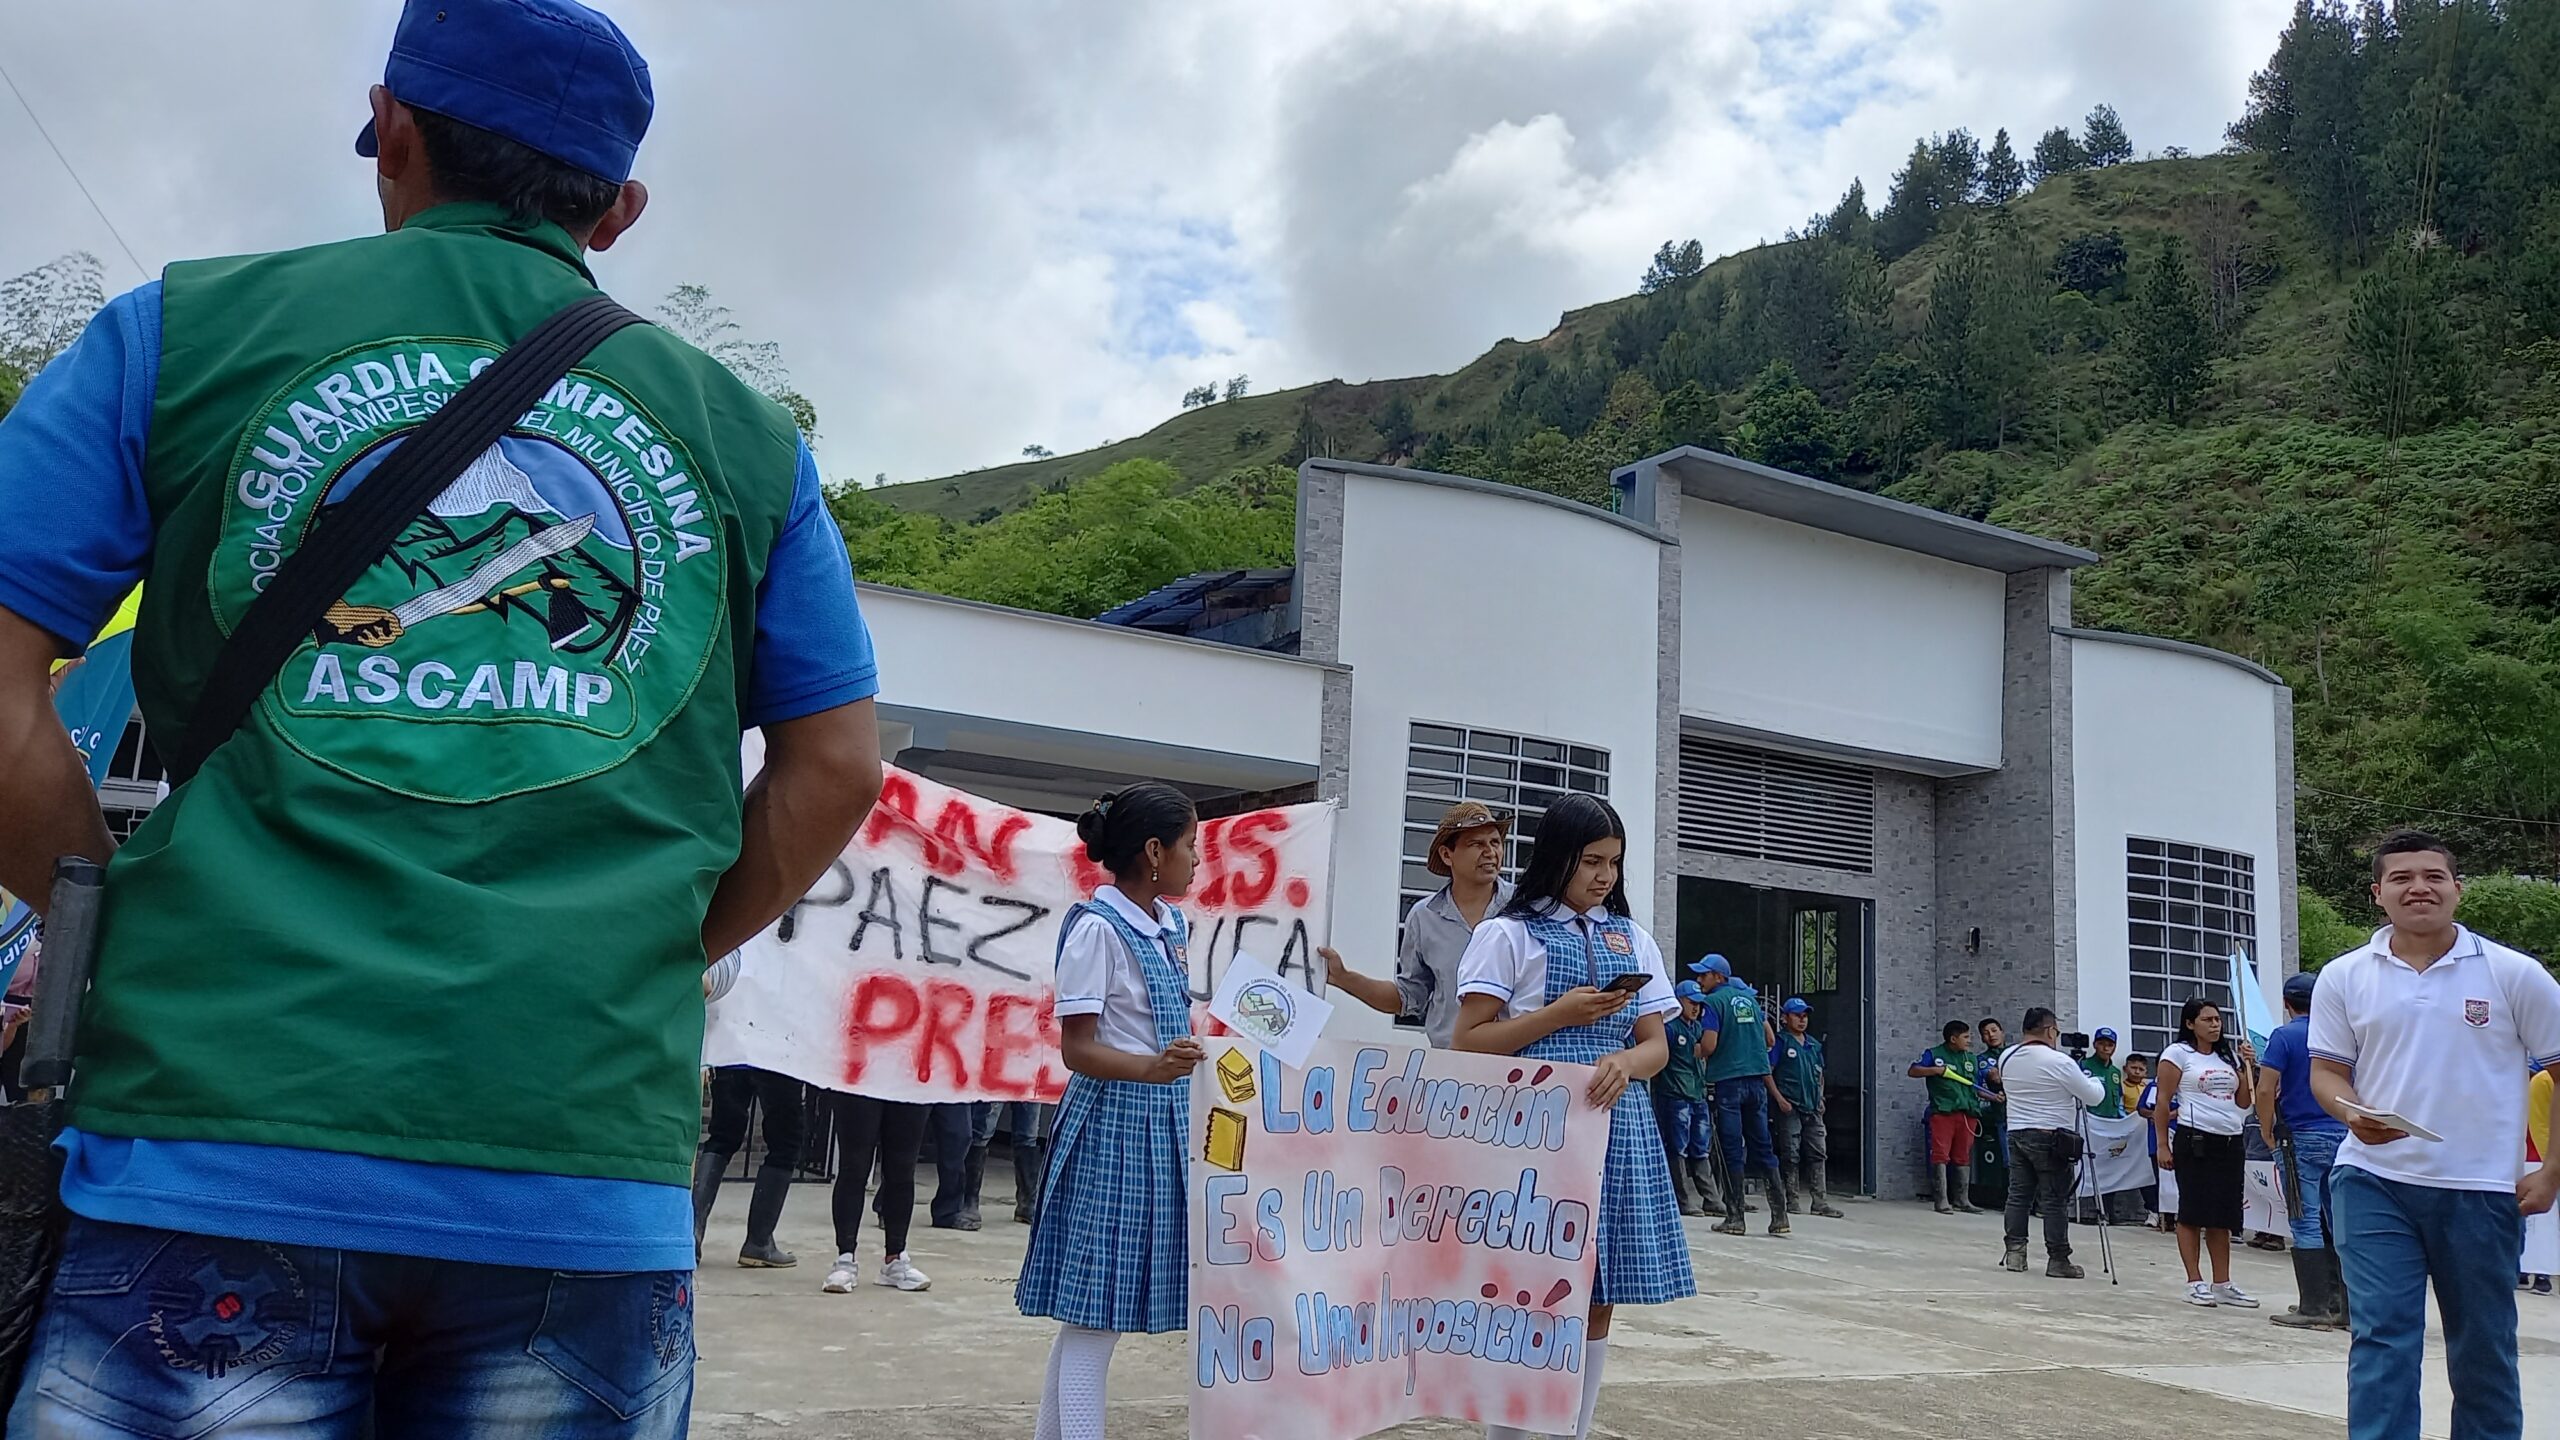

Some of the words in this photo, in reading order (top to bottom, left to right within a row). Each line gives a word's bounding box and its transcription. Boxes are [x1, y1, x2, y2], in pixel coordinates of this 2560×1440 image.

[237, 352, 456, 510] GUARDIA
[249, 449, 325, 594] OCIACION
[562, 425, 662, 554] MUNICIPIO
[641, 560, 666, 600] DE
[302, 654, 613, 717] ASCAMP
[616, 600, 661, 676] PAEZ
[866, 774, 1033, 886] AN
[1230, 1011, 1279, 1048] ASCAMP
[1260, 1049, 1335, 1134] La
[1348, 1048, 1571, 1151] Educación
[1205, 1174, 1286, 1265] Es
[1302, 1170, 1364, 1252] Un
[1379, 1165, 1589, 1261] Derecho
[1197, 1304, 1274, 1388] No
[1296, 1291, 1376, 1376] Una
